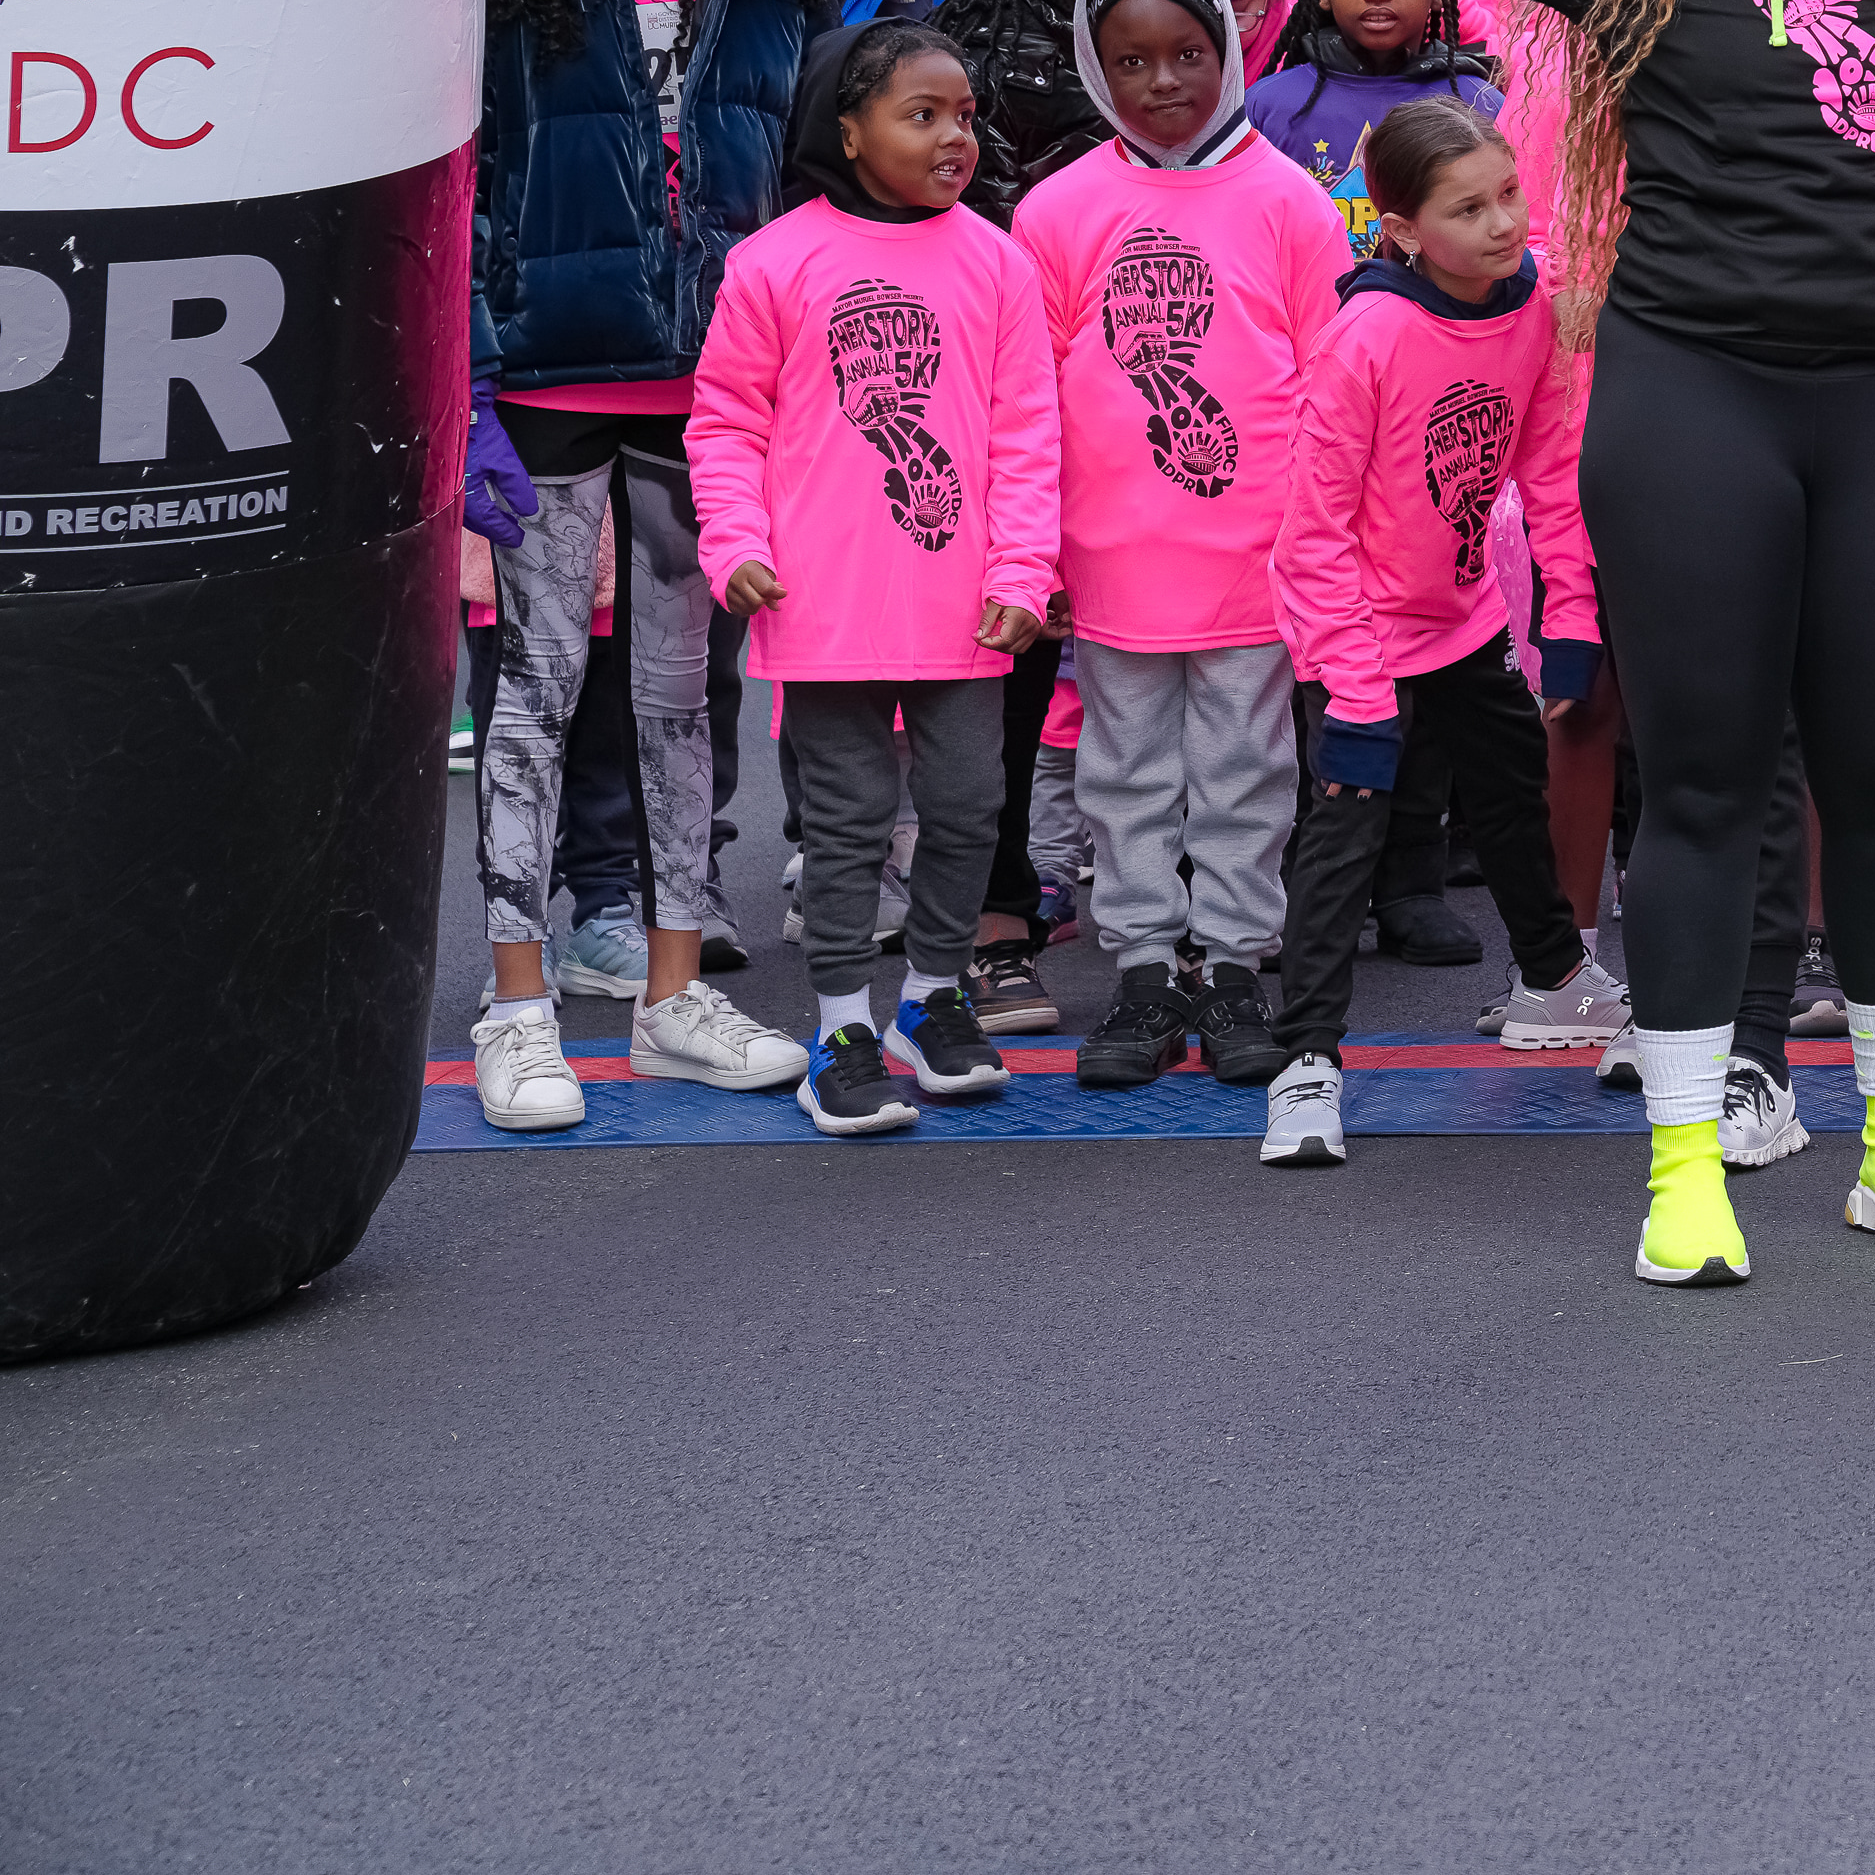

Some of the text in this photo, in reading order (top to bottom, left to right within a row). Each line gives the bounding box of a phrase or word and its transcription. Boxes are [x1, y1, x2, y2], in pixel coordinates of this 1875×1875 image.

[7, 46, 216, 154] DC
[1833, 117, 1870, 149] DPR
[1133, 244, 1154, 253] MURIEL
[1155, 243, 1180, 251] BOWSER
[1111, 259, 1209, 302] HERSTORY
[832, 302, 853, 314] MAYOR
[854, 295, 875, 306] MURIEL
[876, 293, 902, 301] BOWSER
[1116, 300, 1208, 338] ANNUAL 5K
[832, 309, 936, 354] HERSTORY
[845, 351, 934, 389] ANNUAL 5K
[1215, 415, 1238, 473] FITDC
[1161, 463, 1196, 492] DPR
[1439, 450, 1479, 482] ANNUAL
[46, 486, 288, 536] RECREATION
[944, 467, 962, 527] FITDC
[901, 516, 925, 545] DPR
